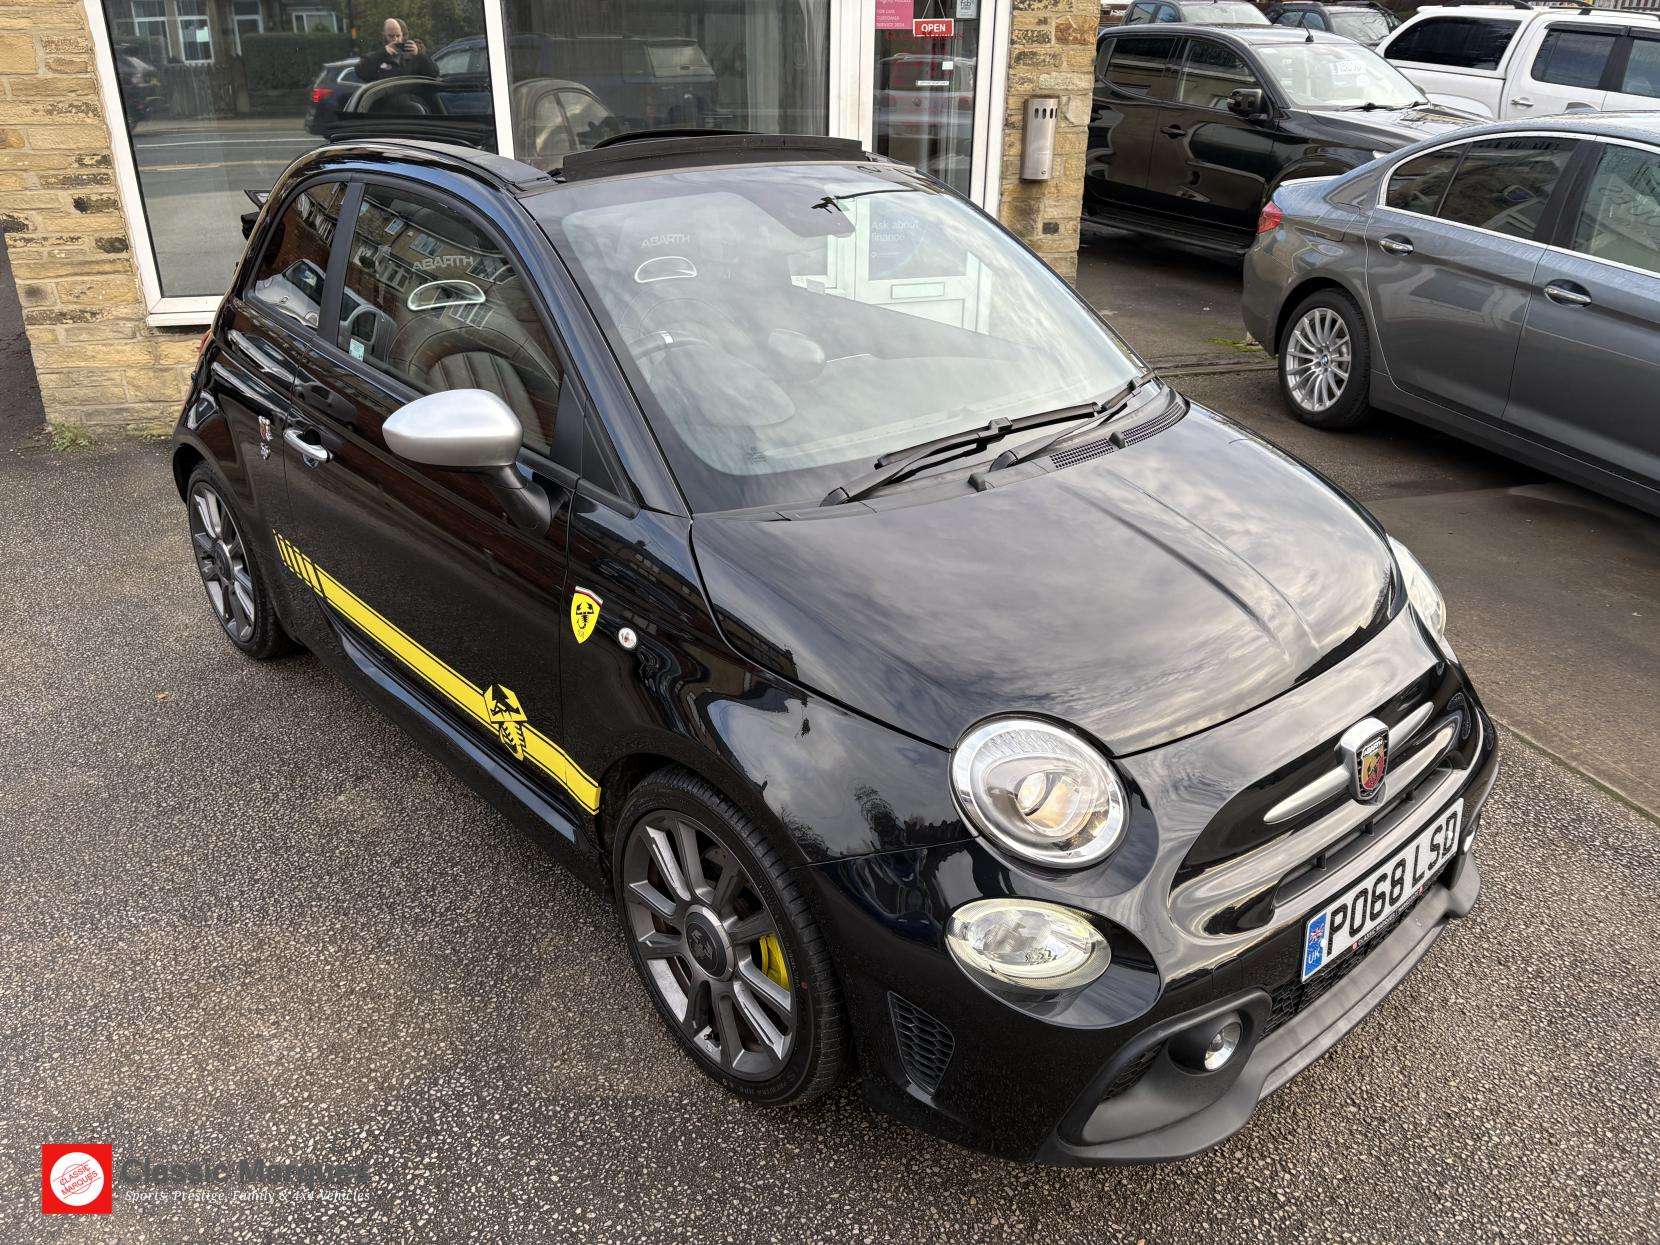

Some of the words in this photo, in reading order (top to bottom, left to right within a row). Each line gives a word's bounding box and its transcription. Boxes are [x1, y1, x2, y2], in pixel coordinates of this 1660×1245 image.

[921, 23, 946, 32] OPEN
[871, 221, 889, 230] Ask
[640, 233, 690, 248] ABARTH
[412, 255, 473, 270] ABARTH
[1411, 811, 1459, 889] LSD
[1308, 949, 1320, 964] UK
